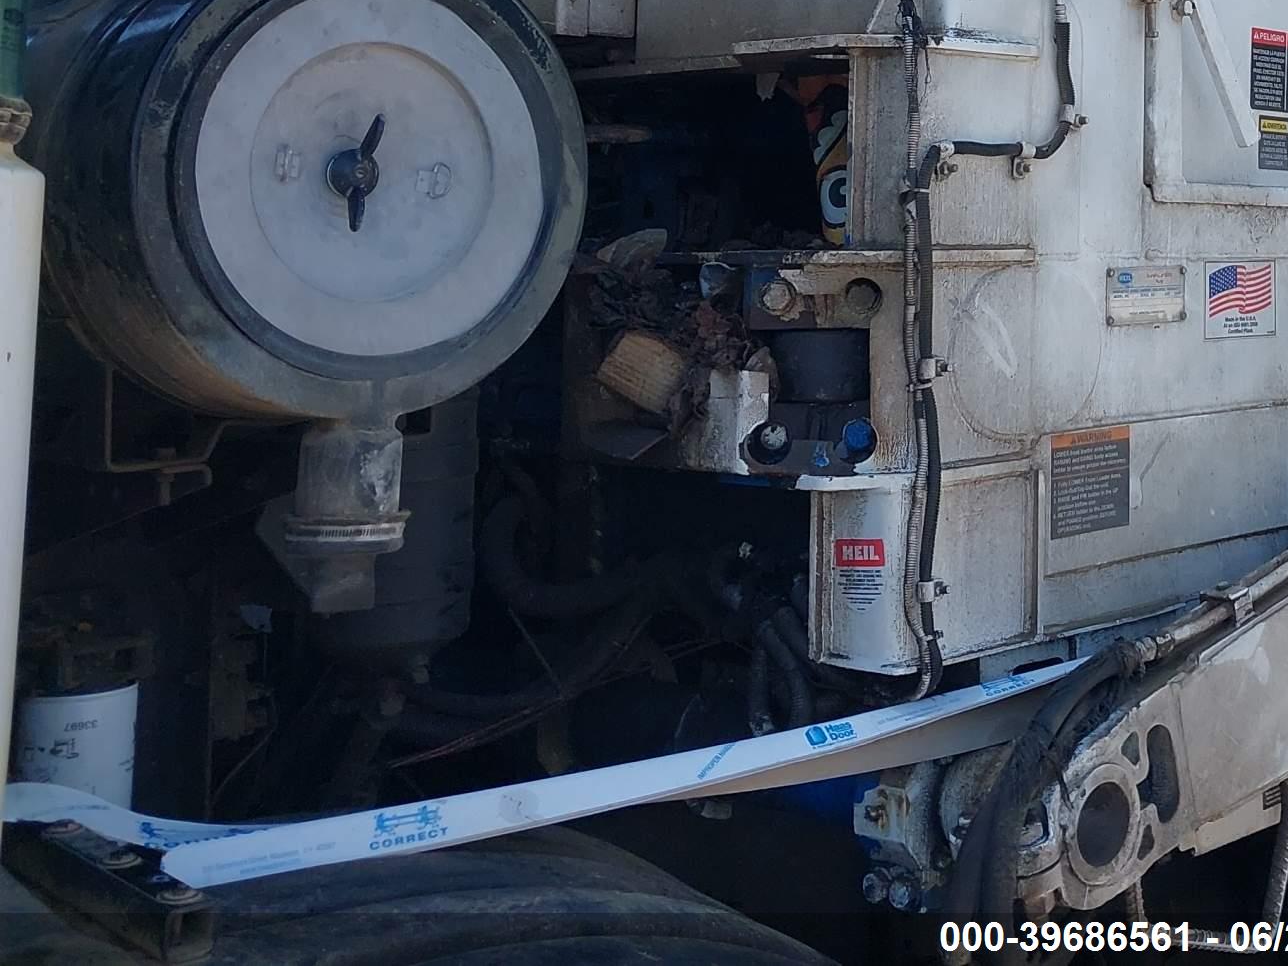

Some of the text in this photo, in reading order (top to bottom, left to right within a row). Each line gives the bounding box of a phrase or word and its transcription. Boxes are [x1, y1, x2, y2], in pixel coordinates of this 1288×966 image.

[1260, 33, 1285, 42] PELIGRO
[843, 546, 880, 560] HEIL
[825, 722, 852, 733] Haas
[369, 827, 448, 850] CORRECT
